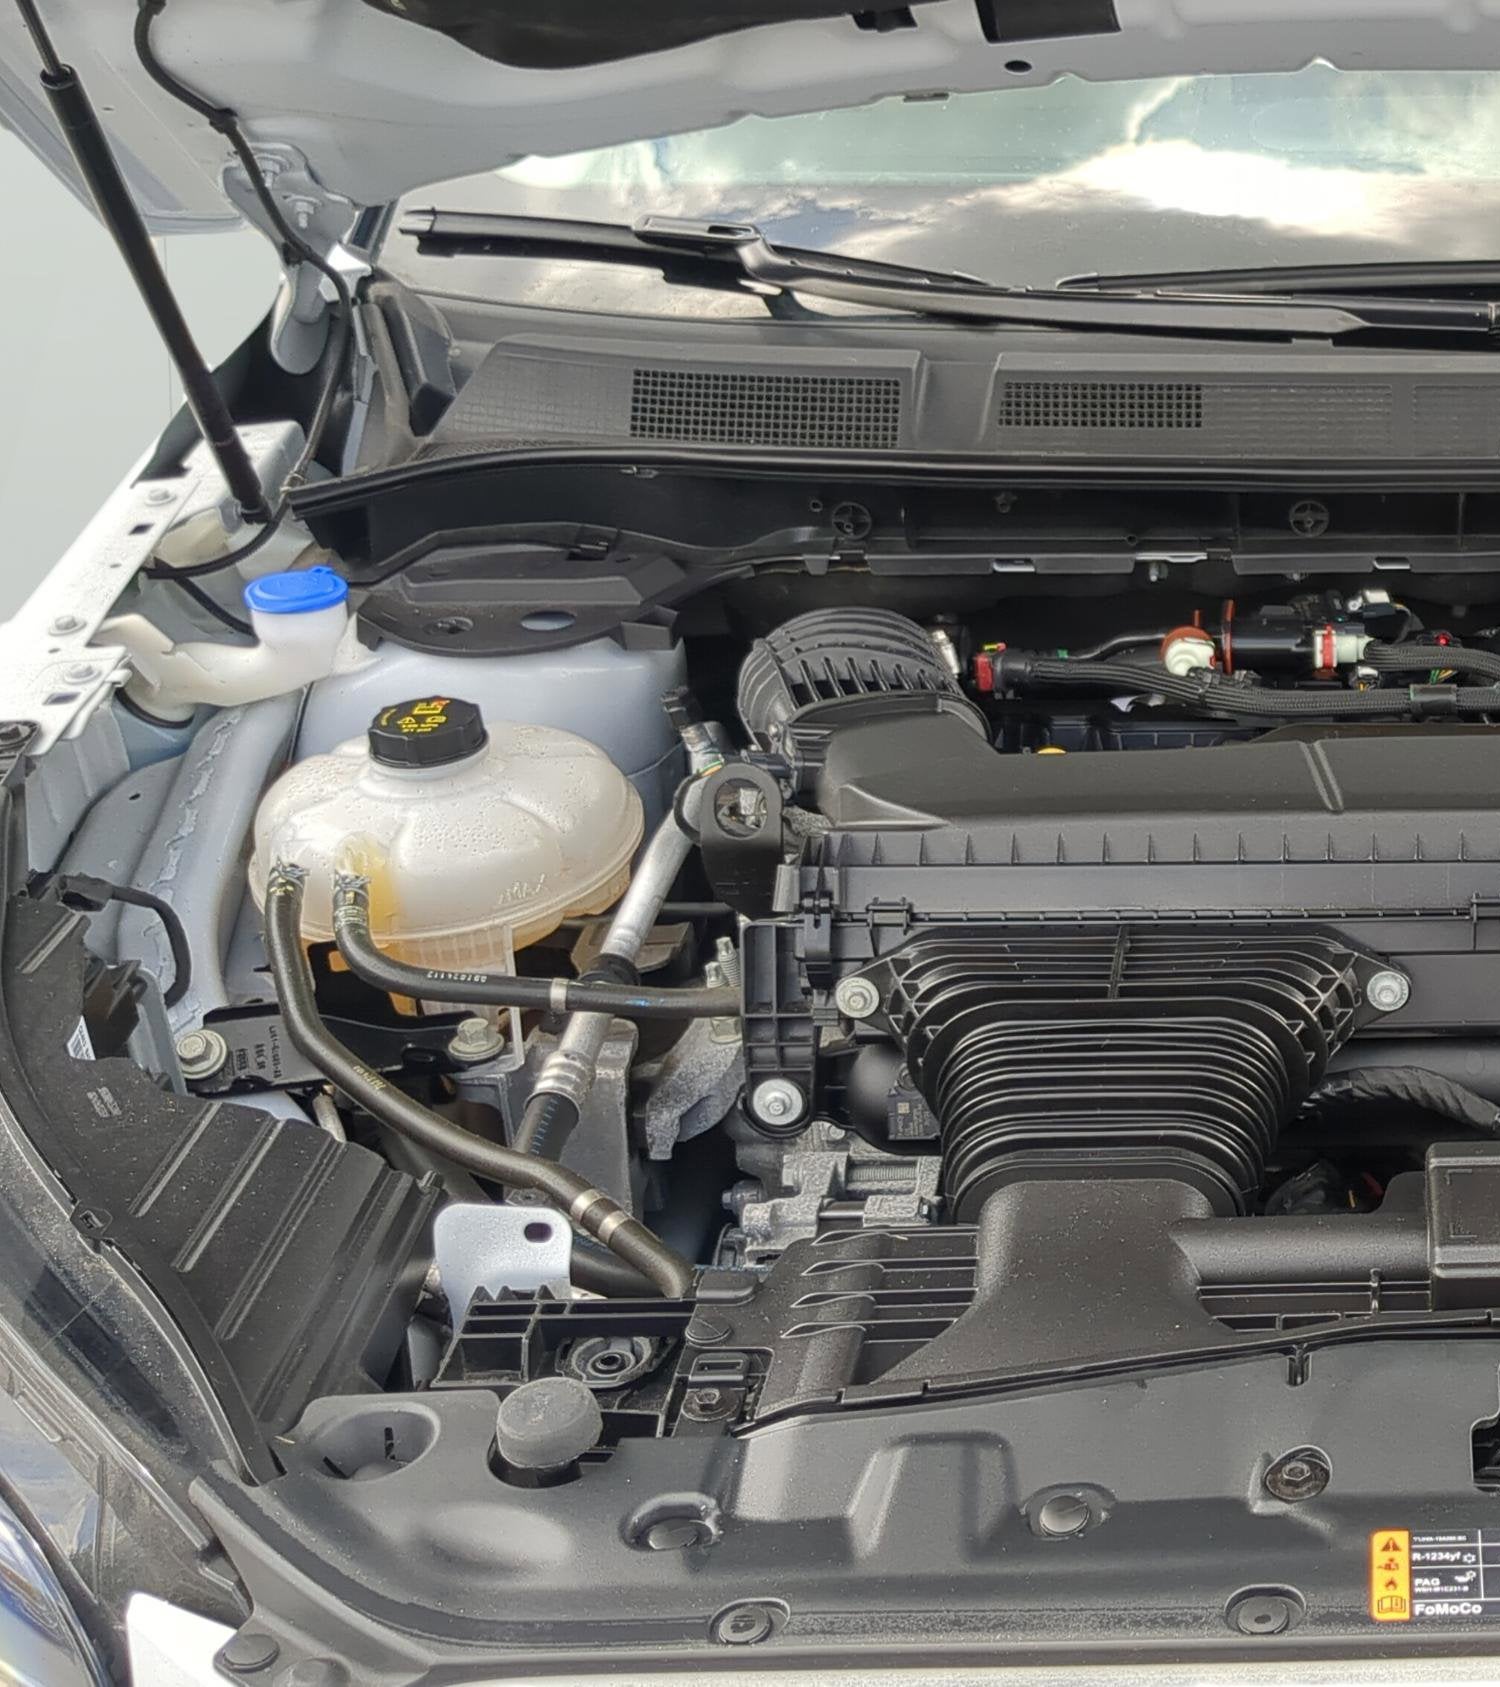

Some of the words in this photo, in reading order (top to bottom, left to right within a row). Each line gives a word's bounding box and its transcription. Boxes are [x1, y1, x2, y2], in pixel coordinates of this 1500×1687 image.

[1412, 1551, 1461, 1562] R-1234yf
[1414, 1577, 1441, 1587] PAG
[1414, 1602, 1483, 1616] FoMoCo
